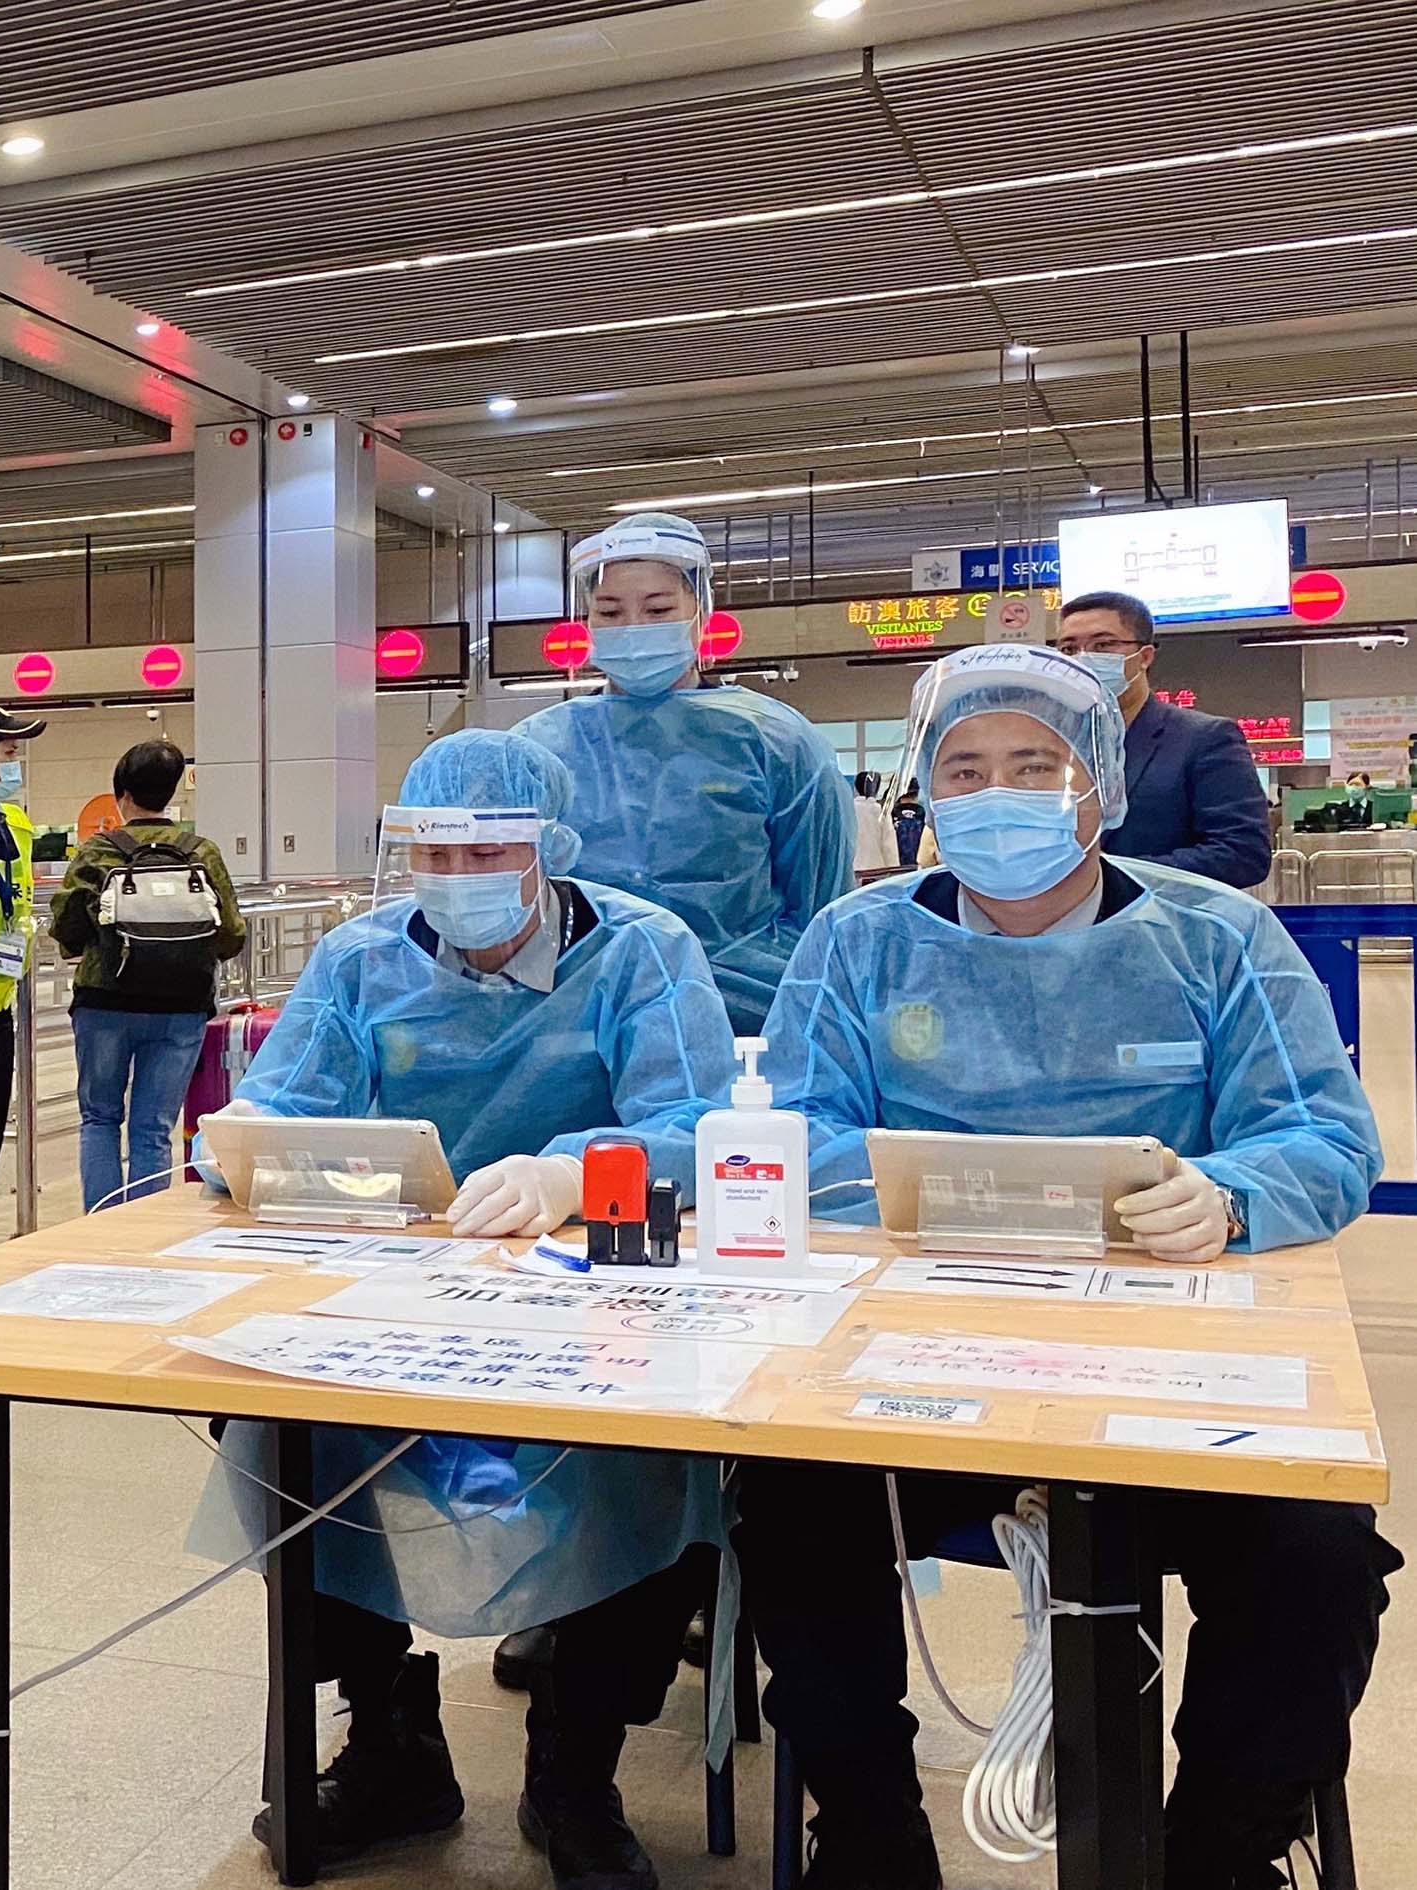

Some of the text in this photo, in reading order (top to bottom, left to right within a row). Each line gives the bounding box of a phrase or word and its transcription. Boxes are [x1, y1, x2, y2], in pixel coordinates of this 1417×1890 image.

[847, 596, 961, 624] 訪澳旅客
[865, 620, 944, 636] VISITANTES
[873, 633, 935, 649] VISITORS
[1195, 1427, 1259, 1447] 7
